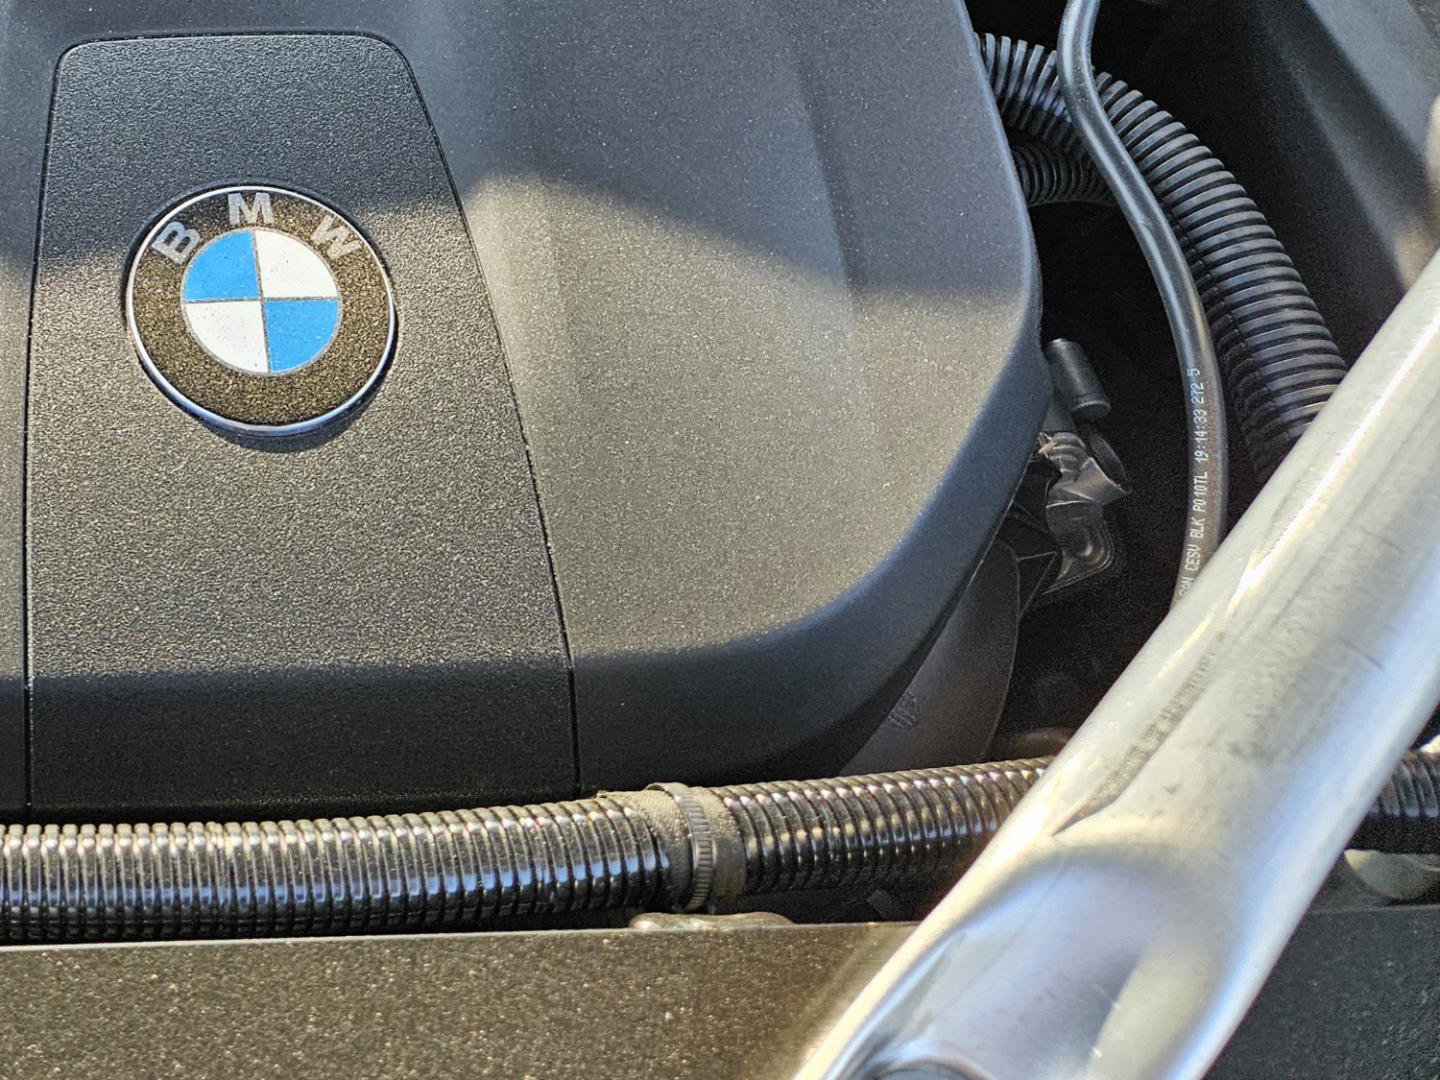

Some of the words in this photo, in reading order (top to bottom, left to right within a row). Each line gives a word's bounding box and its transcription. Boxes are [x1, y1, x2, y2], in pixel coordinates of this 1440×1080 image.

[151, 191, 362, 265] BMW
[1187, 368, 1201, 377] 5
[1190, 382, 1205, 405] 272
[1189, 517, 1205, 539] BLK
